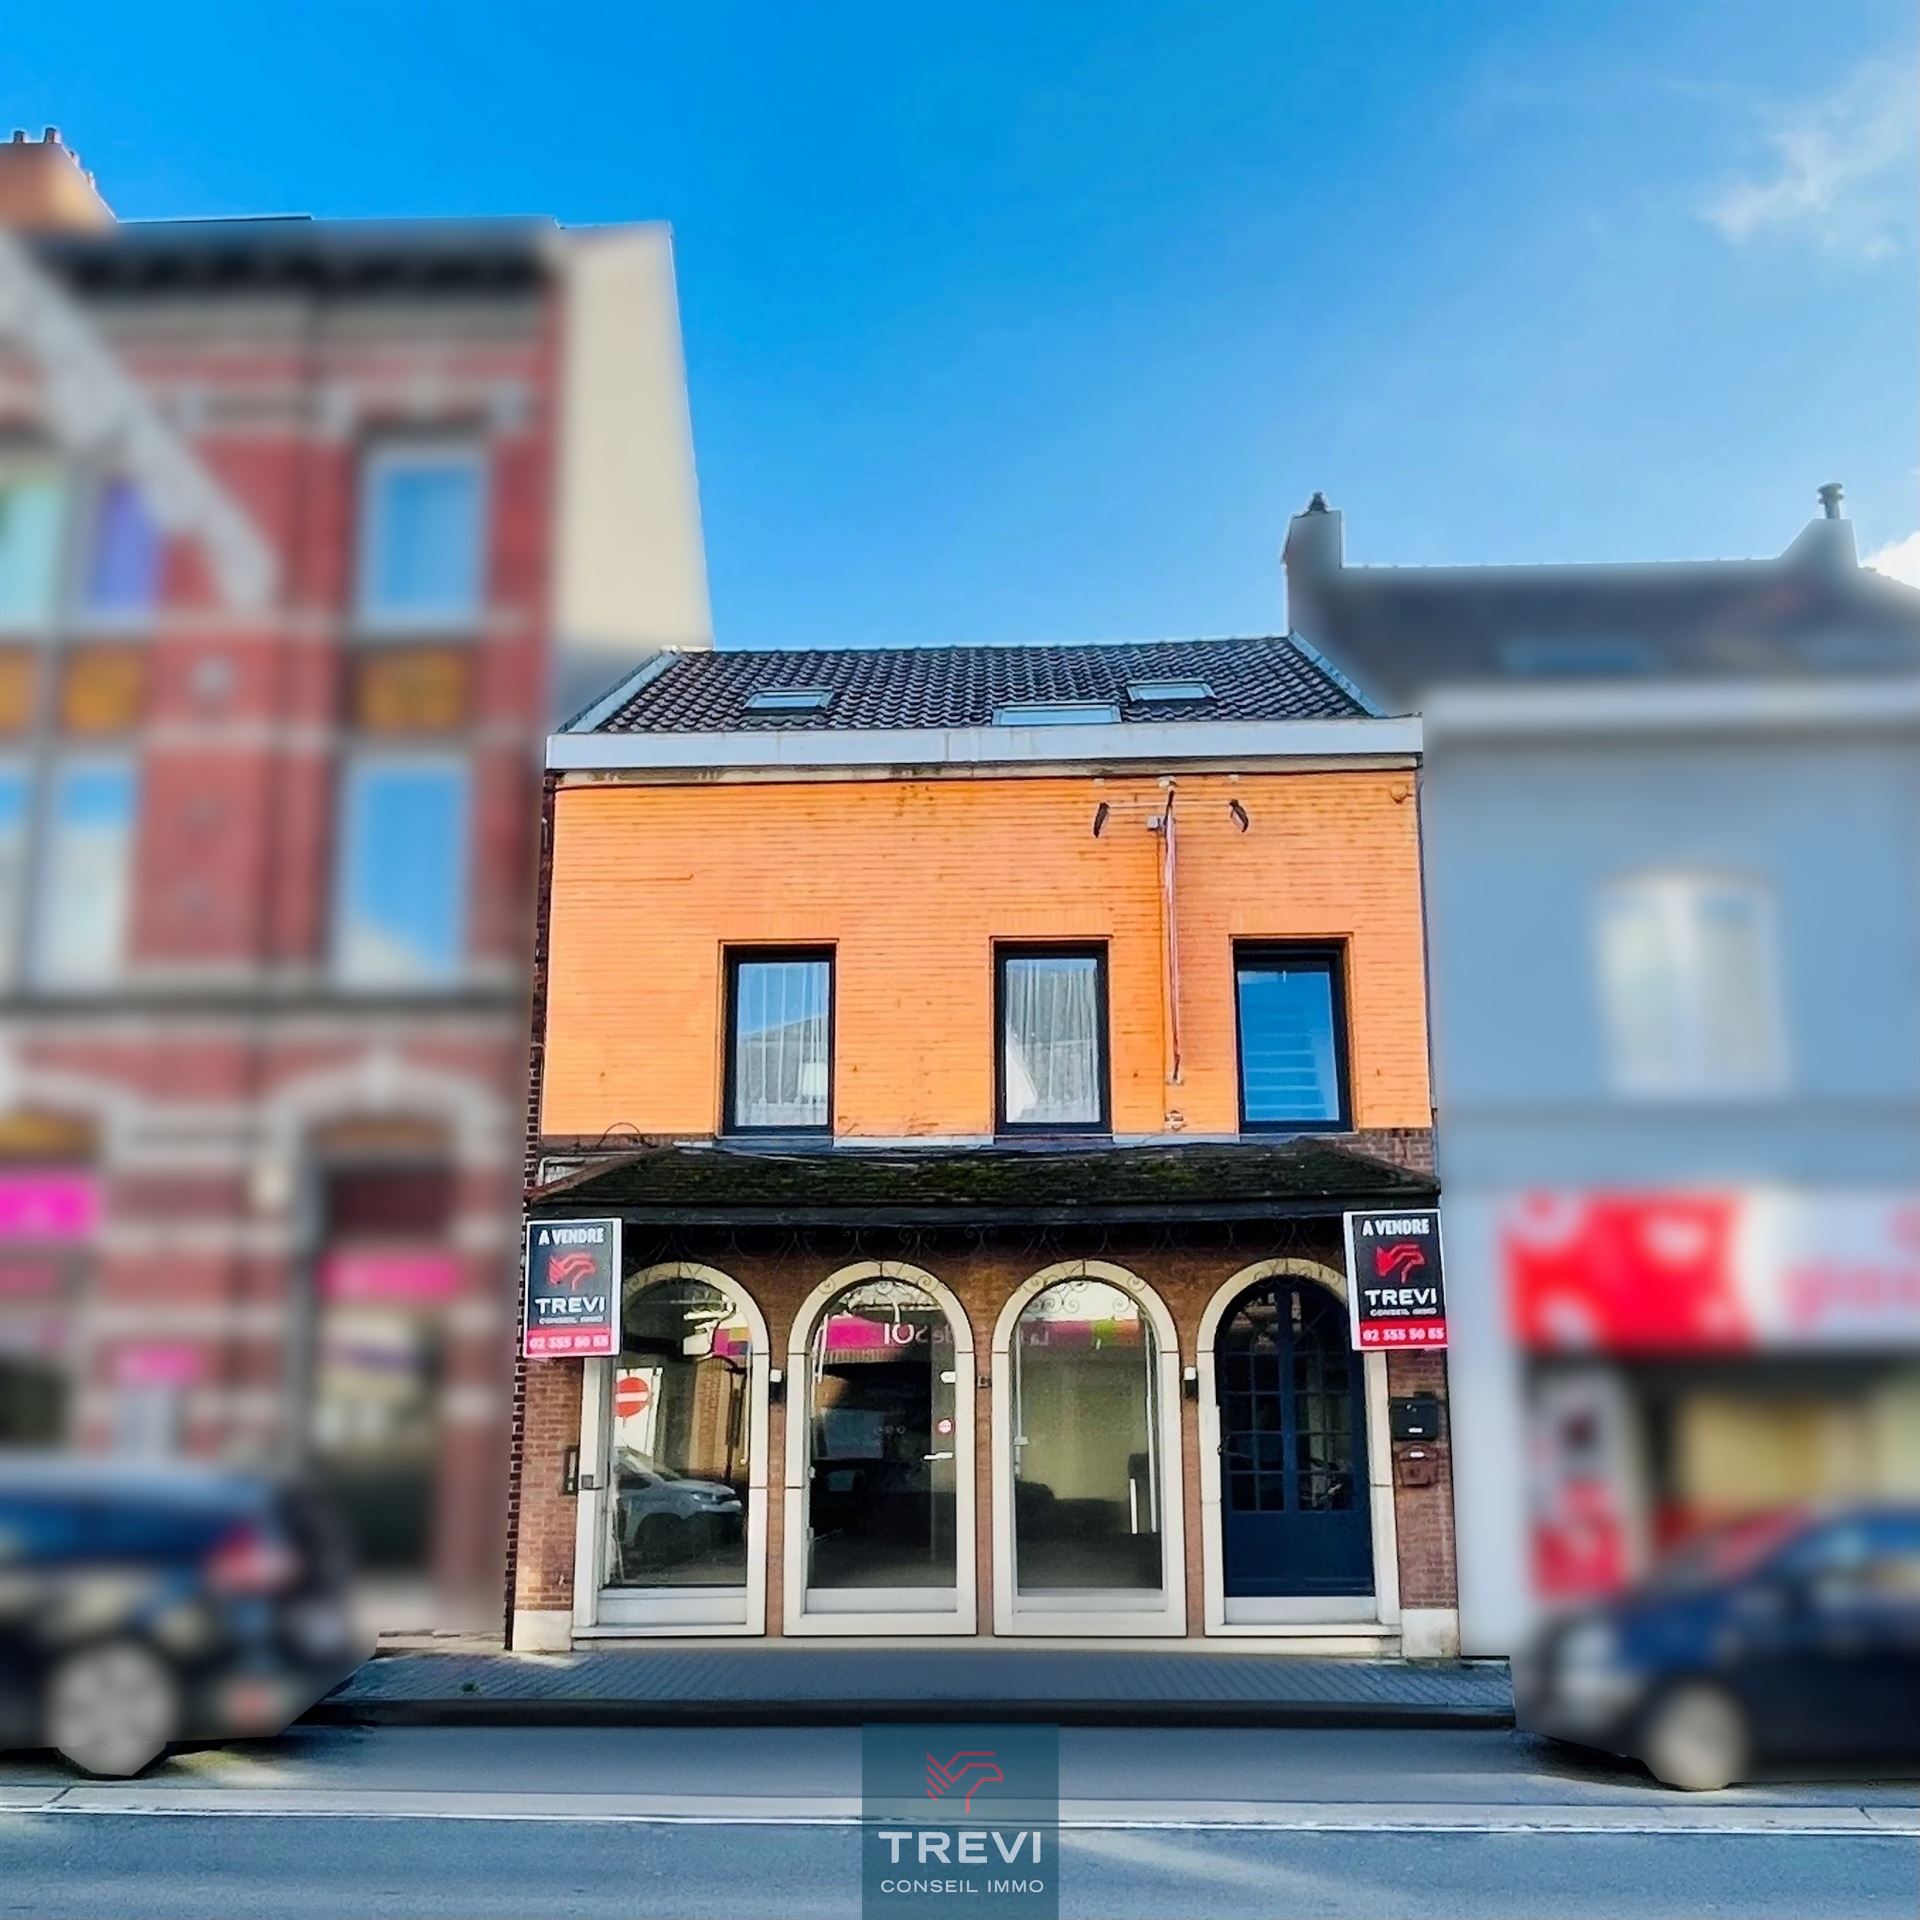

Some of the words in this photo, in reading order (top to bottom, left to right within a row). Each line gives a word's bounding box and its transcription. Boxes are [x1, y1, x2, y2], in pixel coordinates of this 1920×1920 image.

[1362, 1220, 1374, 1236] A
[1375, 1218, 1430, 1235] VENDRE
[538, 1230, 550, 1245] A
[551, 1228, 605, 1245] VENDRE
[534, 1296, 605, 1314] TREVI
[1364, 1287, 1437, 1306] TREVI
